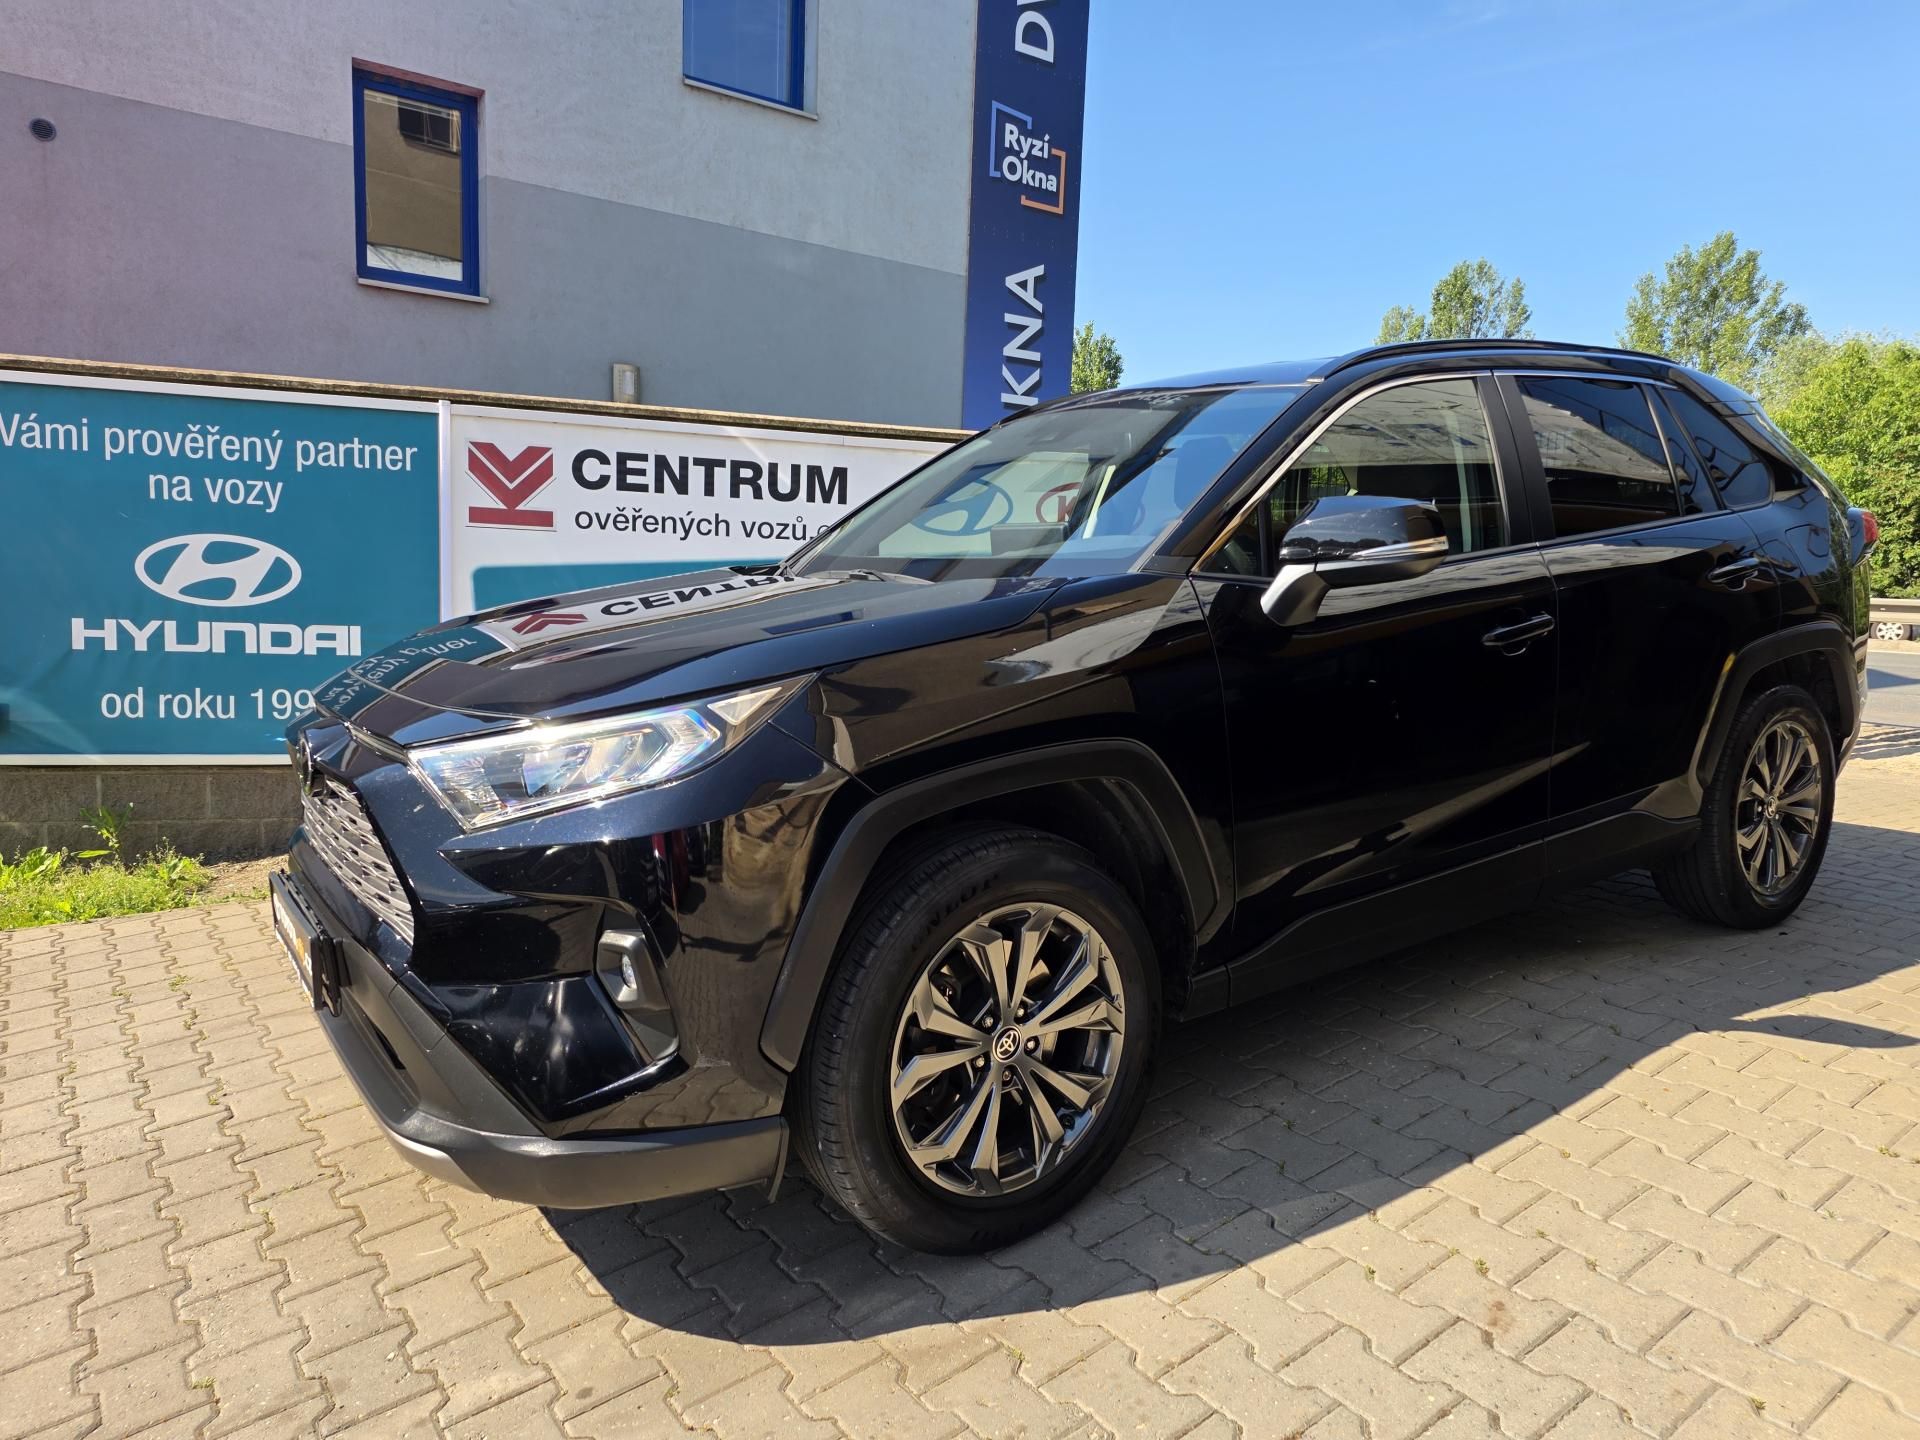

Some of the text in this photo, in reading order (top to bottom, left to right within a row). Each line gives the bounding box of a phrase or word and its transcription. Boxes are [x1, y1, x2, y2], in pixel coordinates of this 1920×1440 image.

[1015, 0, 1054, 63] D
[1004, 122, 1050, 159] Ryzí
[1002, 155, 1057, 192] Okna
[0, 412, 418, 472] Vámi prověřený partner
[149, 474, 283, 513] na vozy
[571, 448, 849, 505] CENTRUM
[574, 506, 730, 541] ověřených
[71, 617, 362, 657] HYUNDAI
[100, 686, 144, 719] od
[159, 687, 235, 720] roku
